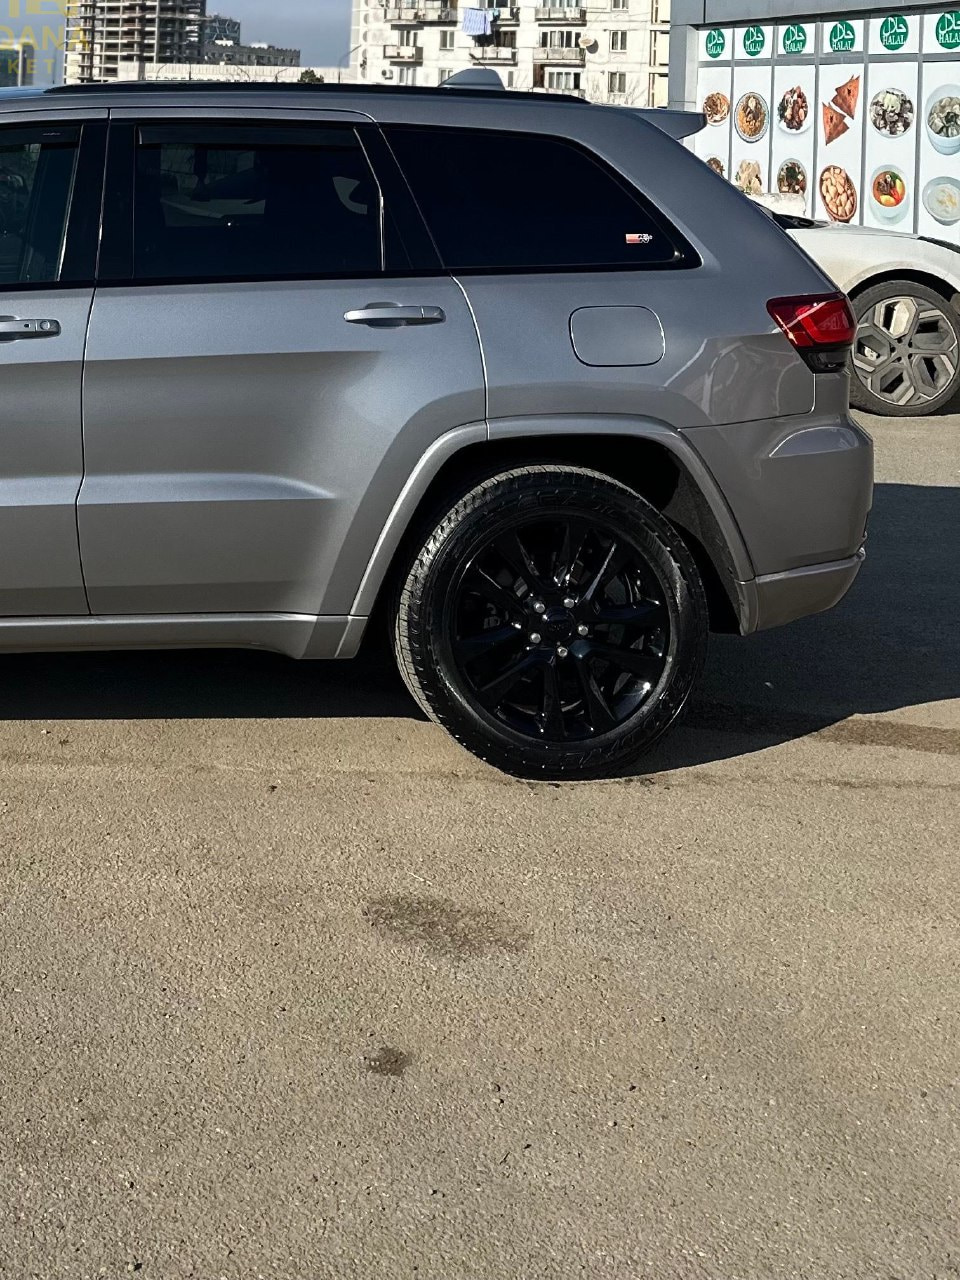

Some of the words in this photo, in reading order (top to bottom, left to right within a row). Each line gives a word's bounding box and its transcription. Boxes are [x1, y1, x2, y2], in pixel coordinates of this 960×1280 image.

[832, 23, 854, 42] حلال
[883, 17, 907, 36] حلال
[746, 26, 764, 45] حلال
[784, 26, 805, 44] حلال
[882, 34, 906, 45] HALAL
[938, 32, 960, 44] HALA
[746, 43, 762, 52] HALAL
[785, 42, 803, 52] HALAL
[831, 40, 852, 50] HALAL
